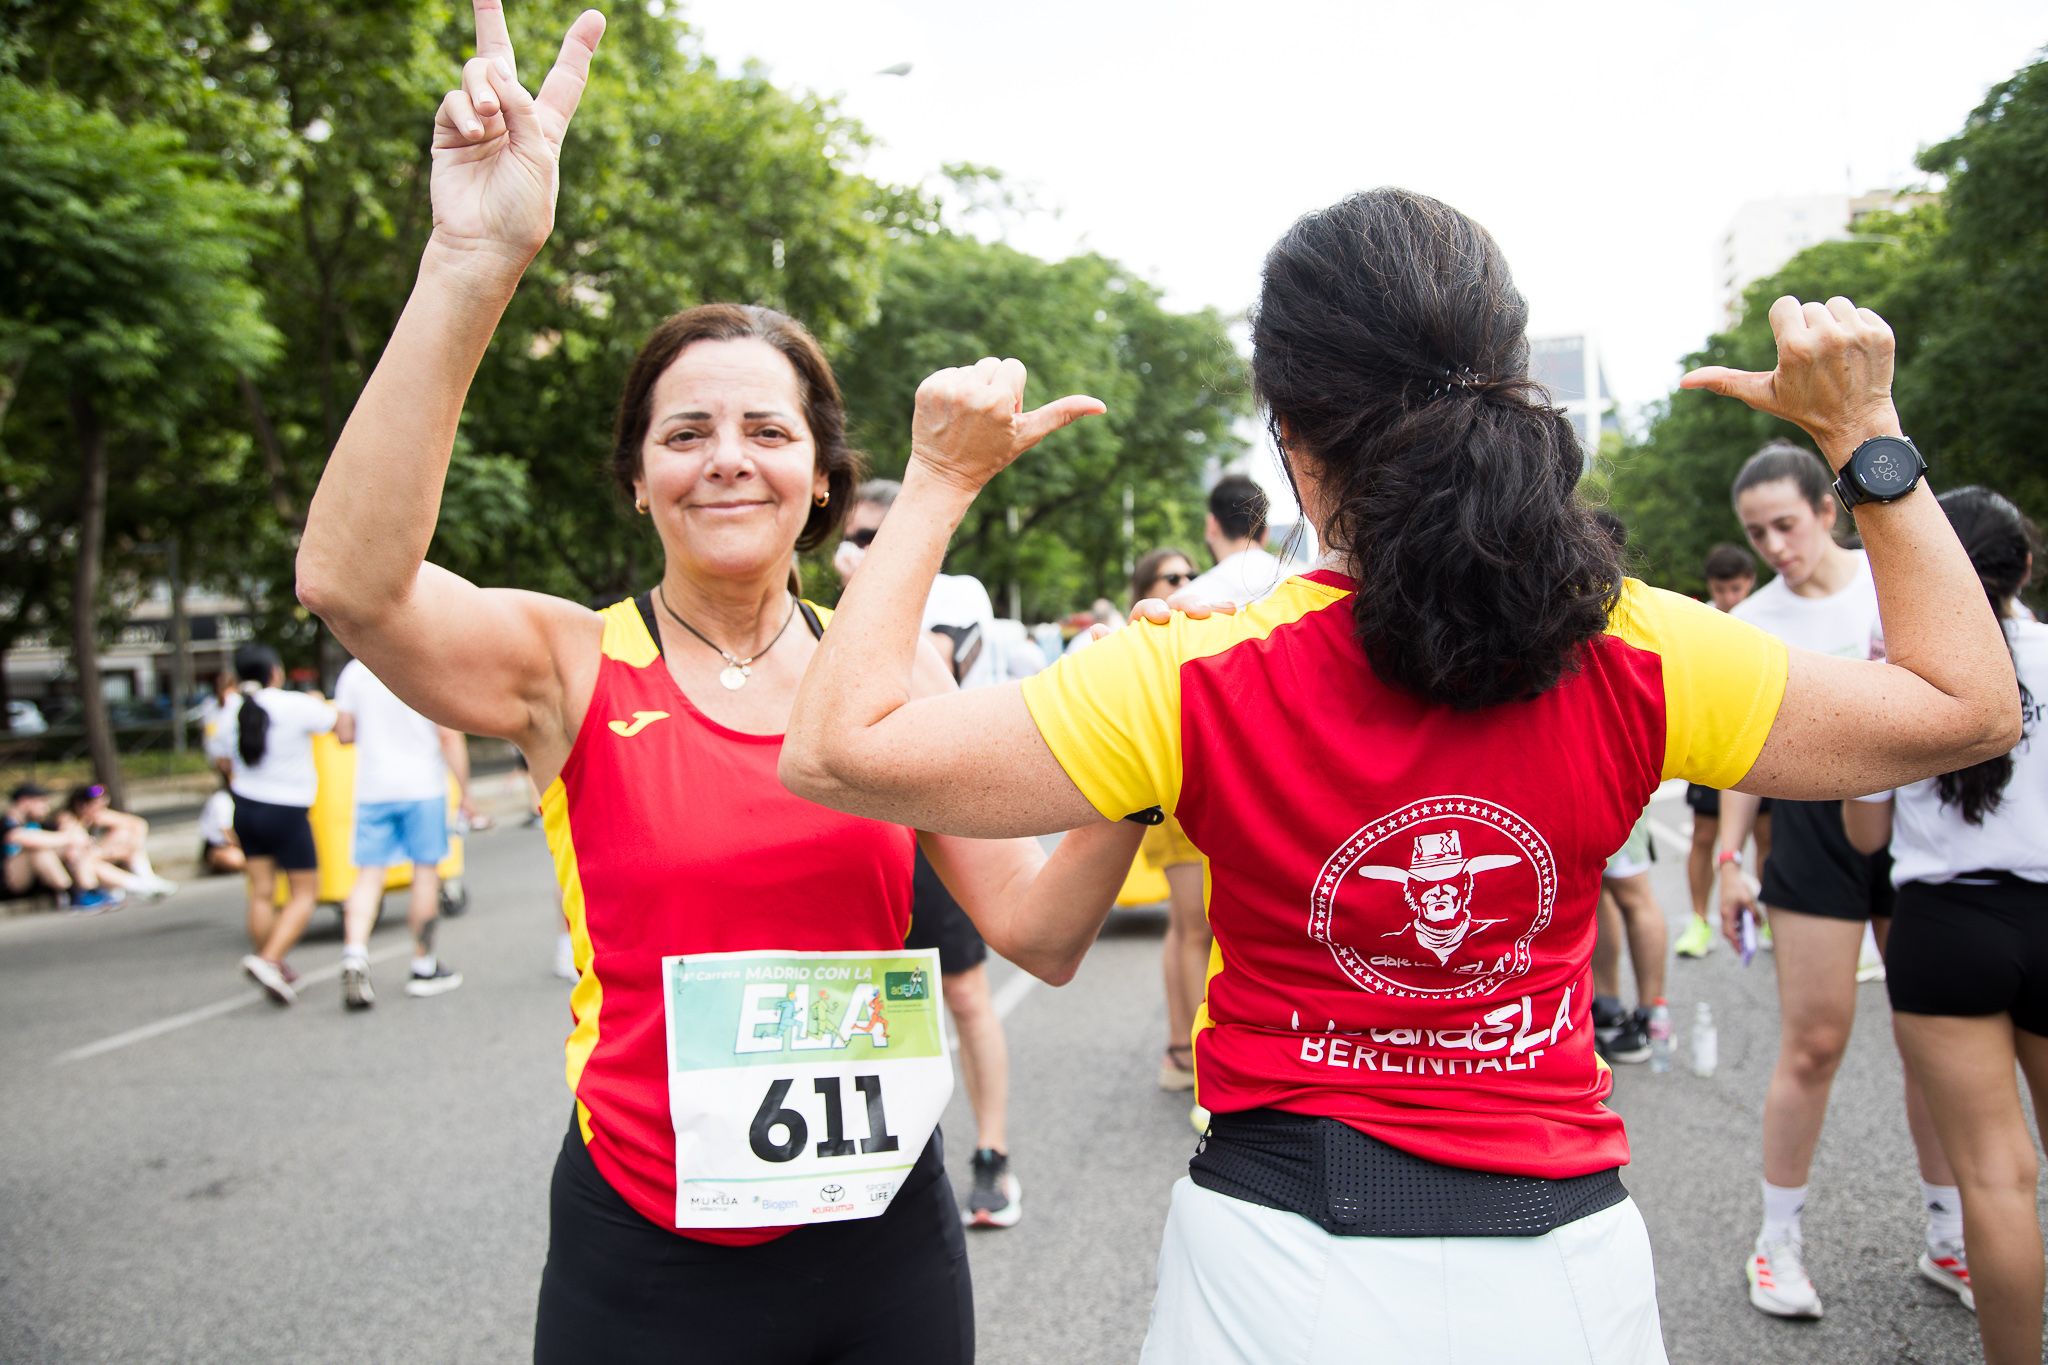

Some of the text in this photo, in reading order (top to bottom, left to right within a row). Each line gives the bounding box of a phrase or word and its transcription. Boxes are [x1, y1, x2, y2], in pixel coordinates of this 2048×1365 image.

[696, 970, 741, 982] Carrera
[745, 966, 810, 980] MADRID
[814, 966, 849, 980] CON
[853, 967, 872, 980] LA
[733, 983, 889, 1055] ELA
[1299, 1036, 1546, 1076] BERLINHALF
[749, 1075, 900, 1163] 611
[761, 1197, 799, 1212] Biogen
[870, 1191, 889, 1202] LIFE
